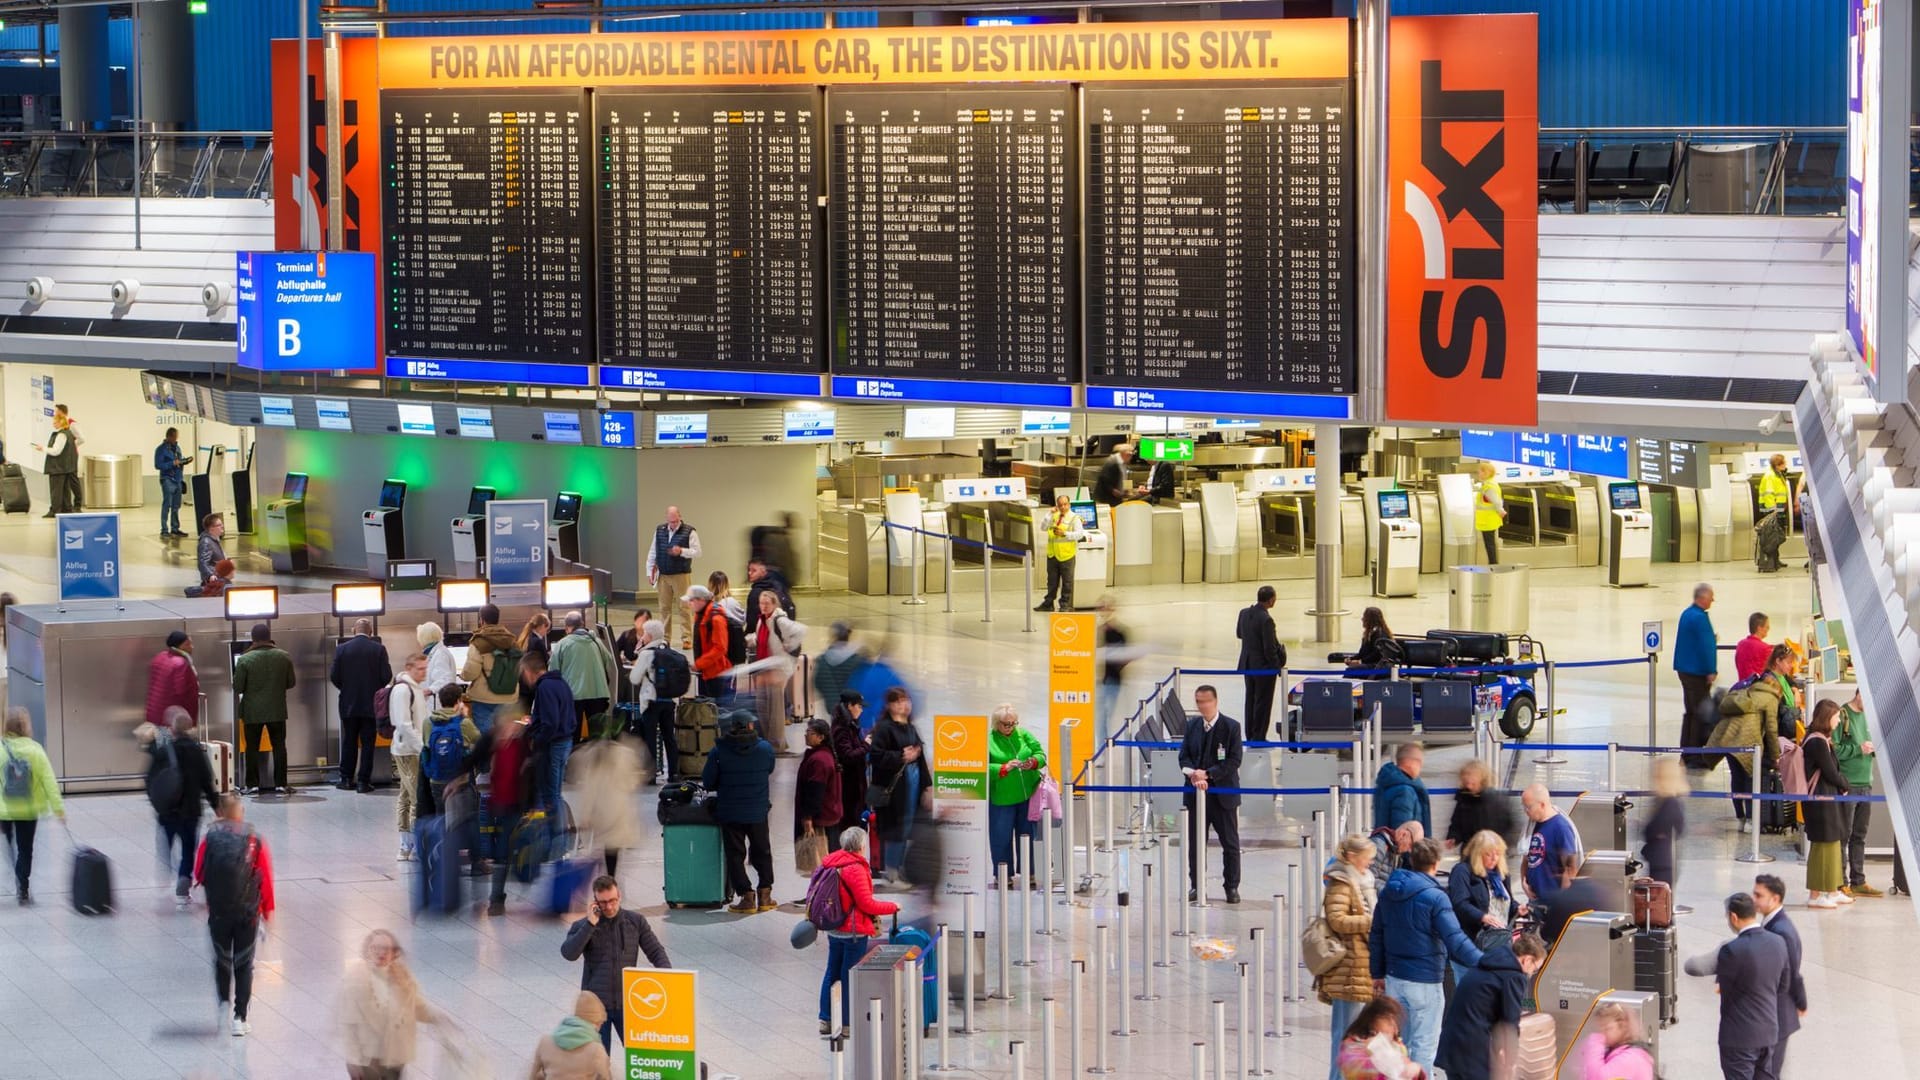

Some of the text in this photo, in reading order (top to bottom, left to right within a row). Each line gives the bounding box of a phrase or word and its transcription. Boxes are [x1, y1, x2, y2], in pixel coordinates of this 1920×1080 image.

[431, 30, 1279, 80] FOR AN AFFORDABLE RENTAL CAR, THE DESTINATION IS SIXT.
[645, 136, 684, 144] THESSALONIKI
[1143, 156, 1174, 164] BRUESSEL
[1144, 197, 1202, 205] LONDON-HEATHROW
[1144, 217, 1171, 225] ZUERICH
[1405, 60, 1506, 380] SIXT
[1144, 258, 1159, 266] GENF
[276, 262, 324, 273] Terminal 1
[1144, 268, 1175, 276] LISSABON
[277, 280, 326, 291] Abflughalle
[884, 282, 913, 290] CHISINAU
[276, 292, 342, 304] Departures hall
[1195, 310, 1218, 318] GAULLE
[240, 315, 247, 353] B
[278, 318, 301, 357] B
[1144, 329, 1179, 337] GAZIANTEP
[1144, 339, 1179, 347] STUTTGART
[924, 351, 950, 359] EXUPERY
[1145, 359, 1187, 367] DUESSELDORF
[604, 422, 626, 432] 428-
[604, 433, 622, 444] 499
[494, 546, 541, 565] Departures B
[495, 547, 516, 555] Abflug
[65, 562, 87, 570] Abflug
[104, 561, 114, 577] B
[1053, 649, 1091, 657] Lufthansa
[938, 758, 983, 768] Lufthansa
[938, 776, 978, 787] Economy
[938, 786, 961, 794] Class
[630, 1030, 689, 1044] Lufthansa
[630, 1055, 683, 1071] Economy
[630, 1068, 661, 1080] Class
